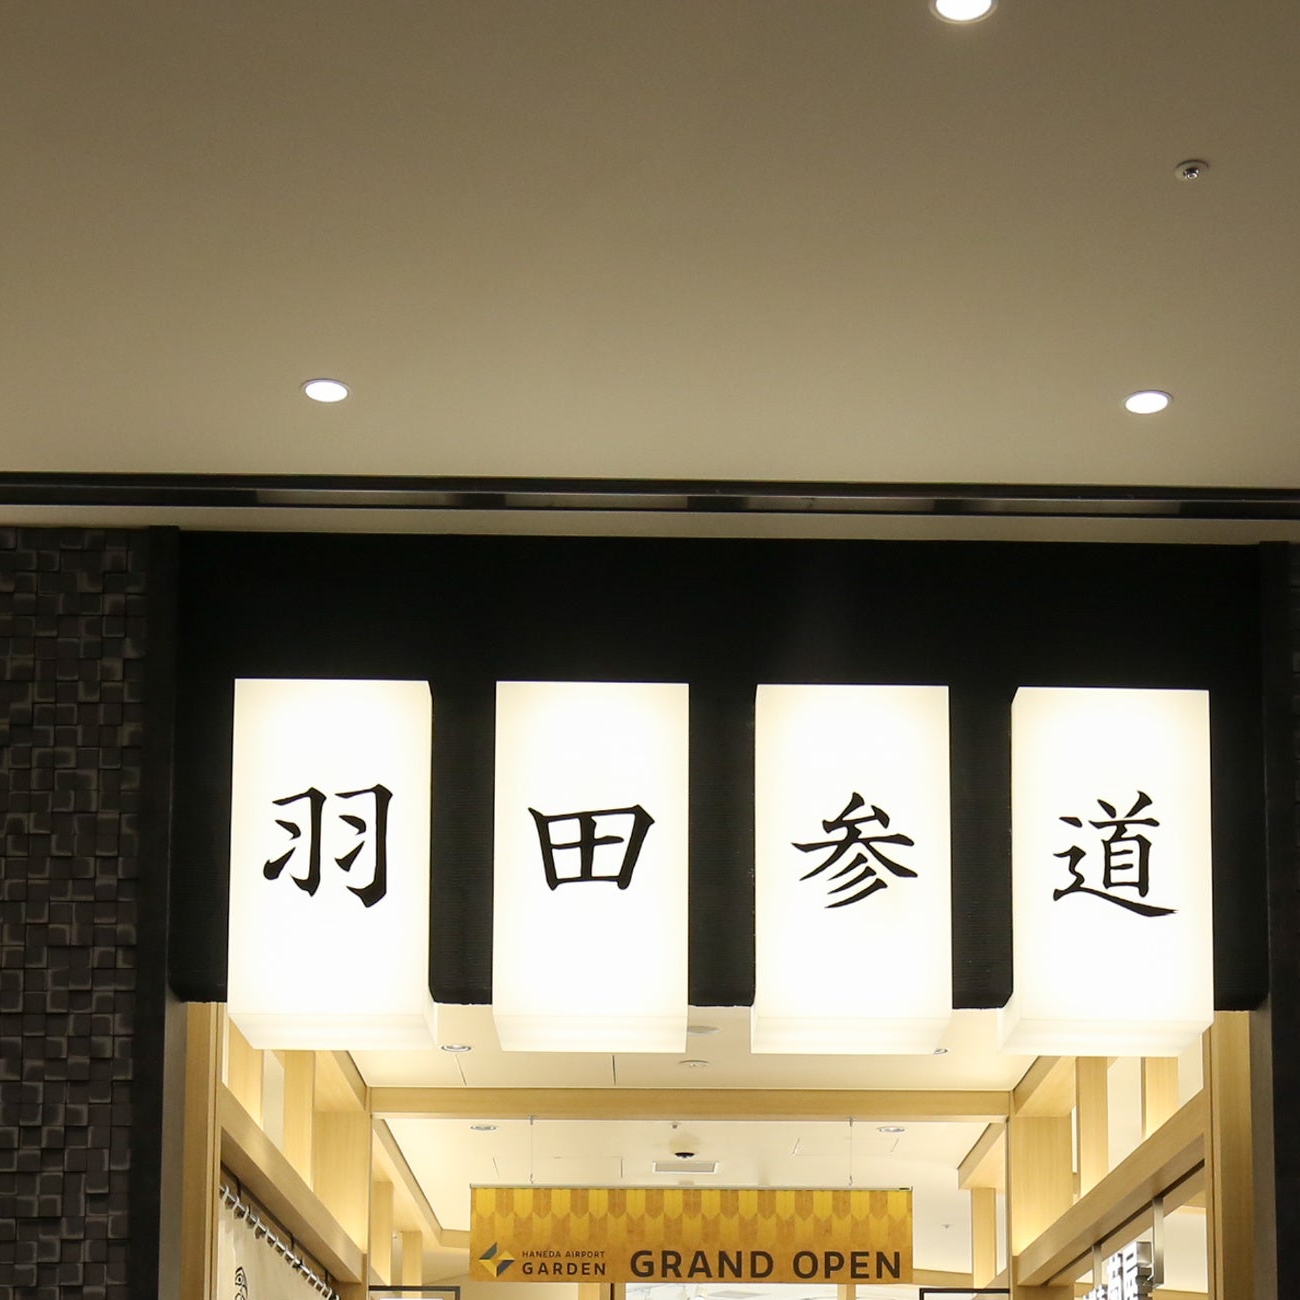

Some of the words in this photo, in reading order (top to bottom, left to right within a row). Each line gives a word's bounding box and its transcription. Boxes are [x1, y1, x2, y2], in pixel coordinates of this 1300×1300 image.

[263, 783, 1179, 918] 羽田参道
[522, 1250, 562, 1258] HANEDA
[564, 1250, 605, 1258] AIRPORT
[630, 1250, 774, 1278] GRAND
[792, 1250, 901, 1279] OPEN
[522, 1262, 607, 1276] GARDEN
